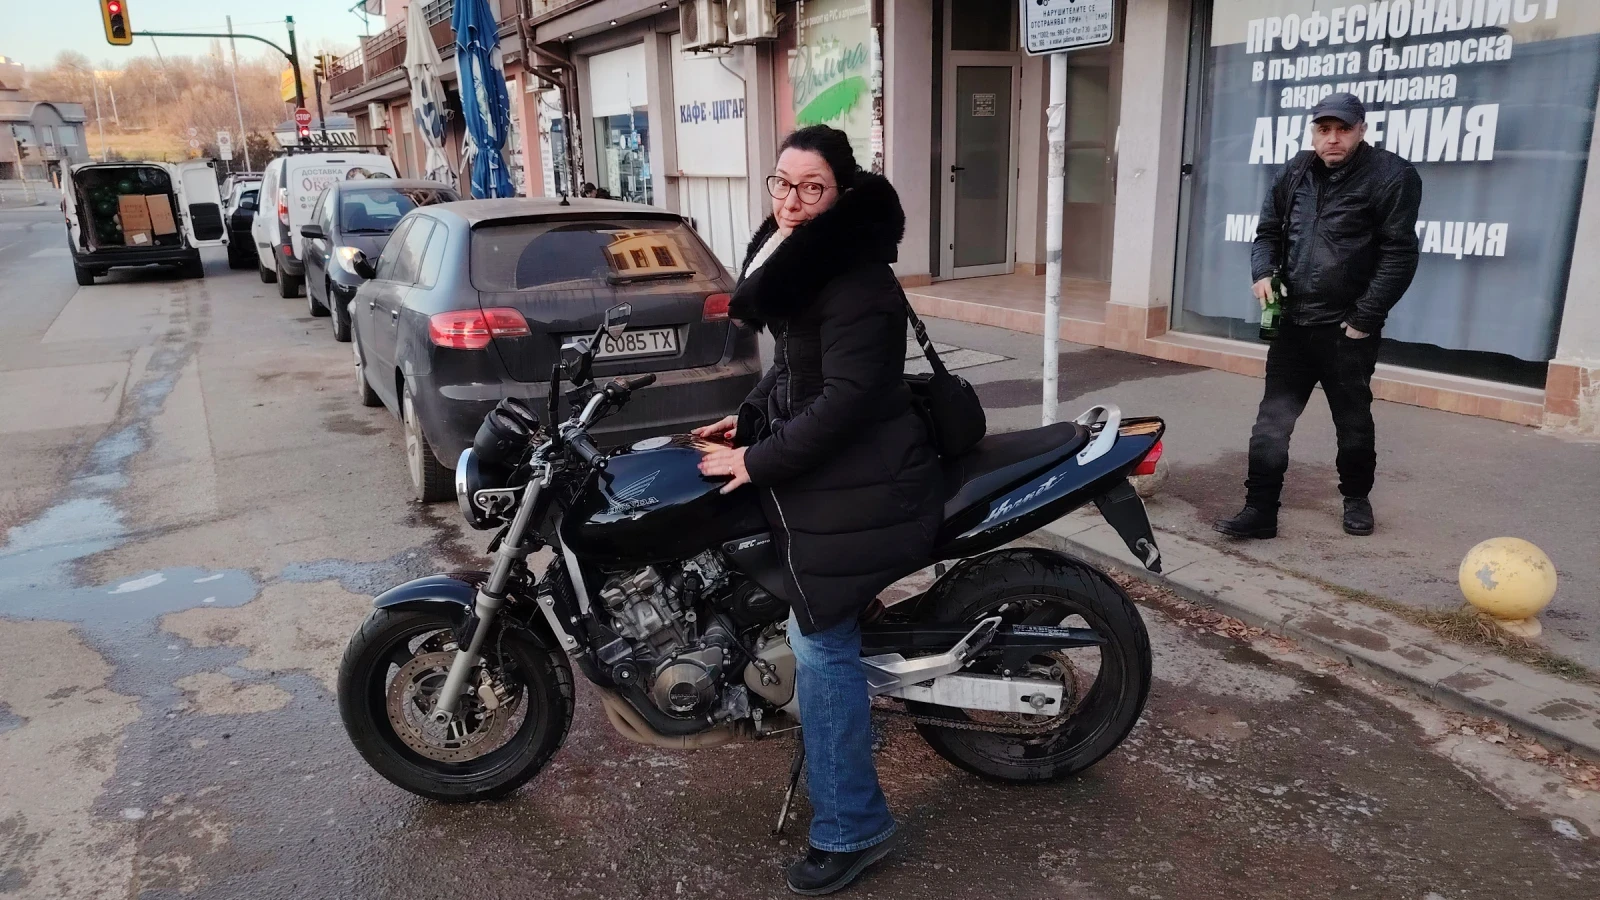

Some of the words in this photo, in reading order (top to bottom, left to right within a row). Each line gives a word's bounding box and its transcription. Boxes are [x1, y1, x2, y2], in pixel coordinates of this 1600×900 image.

[1043, 5, 1086, 17] НАРУШИТЕЛИТЕ
[1089, 4, 1096, 13] СЕ
[1030, 17, 1067, 29] ОТСТРАНЯВАТ
[1252, 61, 1265, 82] в
[1268, 51, 1361, 82] първата
[1368, 34, 1514, 73] българска
[295, 113, 311, 121] STOP
[680, 100, 707, 124] КАФЕ
[1248, 103, 1499, 165] АКЕМИЯ
[301, 168, 343, 176] ДОСТАВКА
[604, 333, 647, 354] 6085
[649, 331, 672, 349] TX
